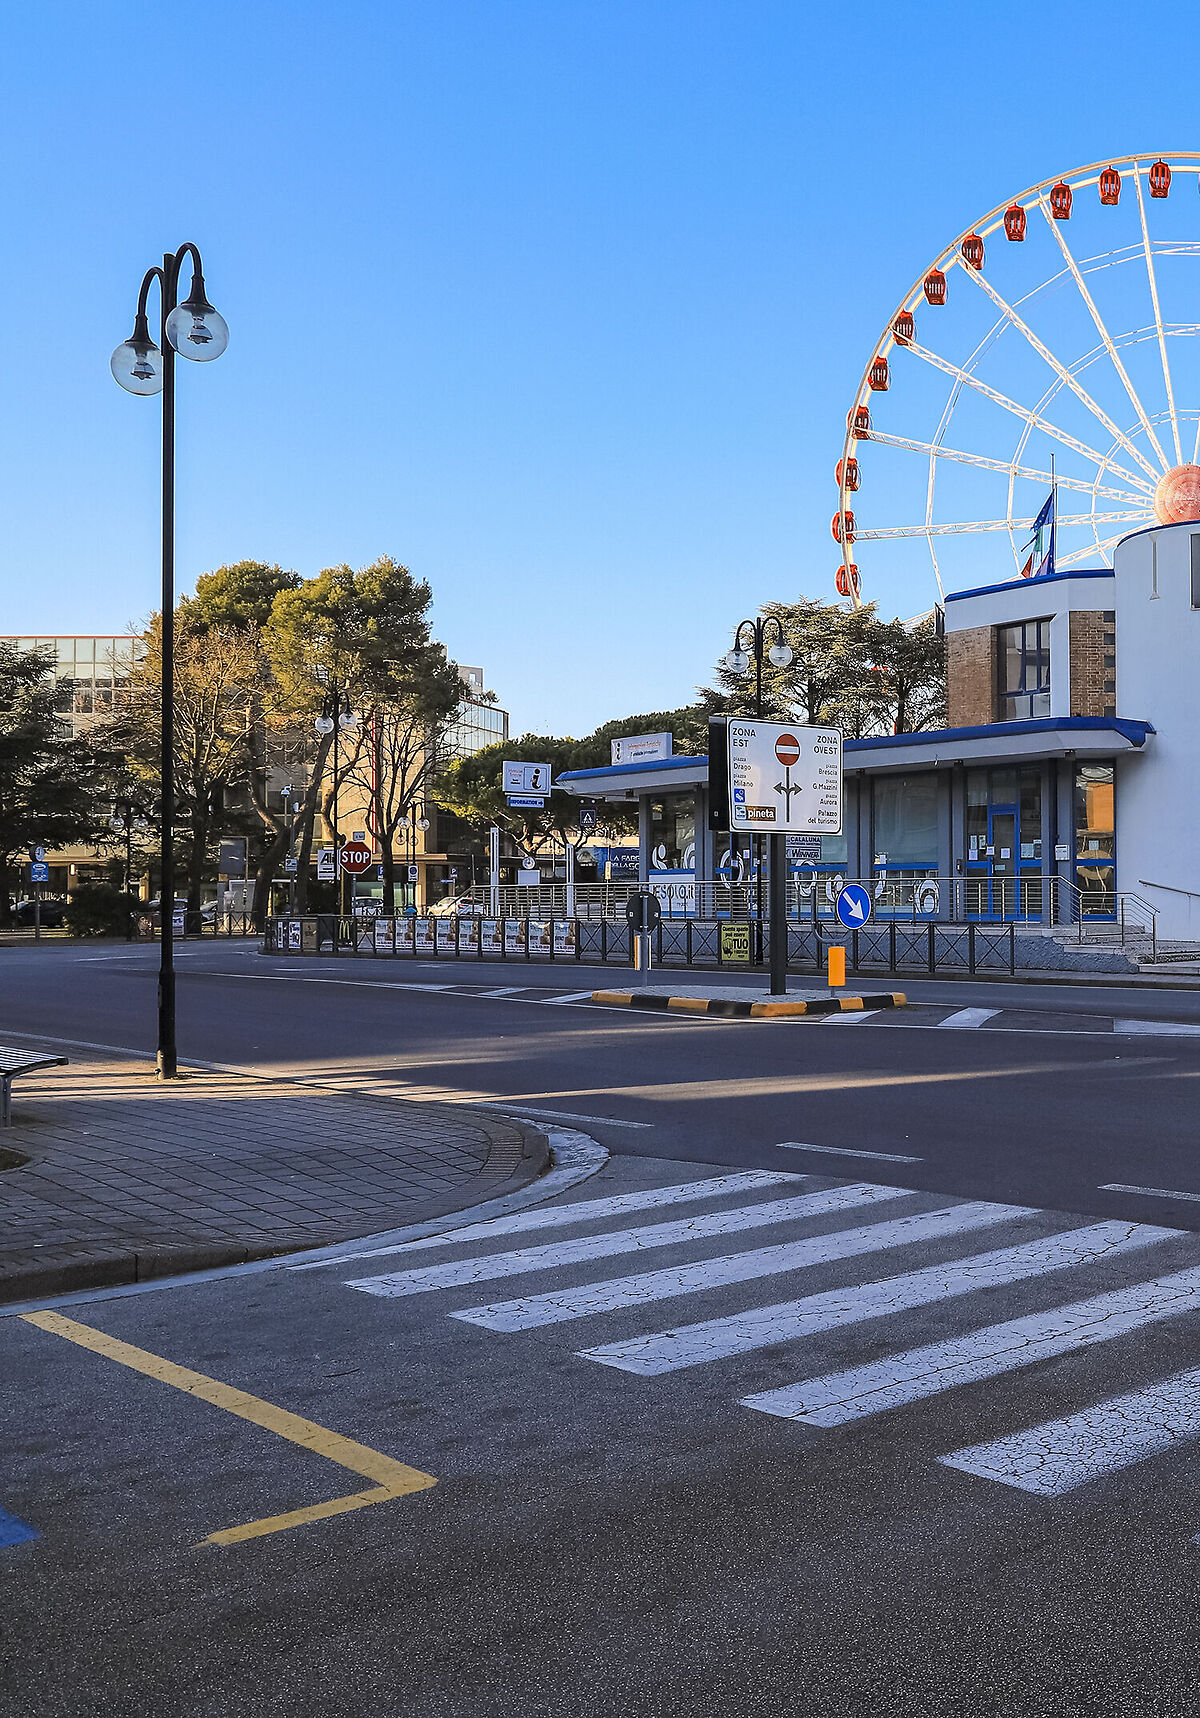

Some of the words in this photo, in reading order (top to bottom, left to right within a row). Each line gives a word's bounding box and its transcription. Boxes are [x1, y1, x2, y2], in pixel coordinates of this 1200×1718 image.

[732, 727, 756, 737] ZONA
[732, 738, 749, 747] EST
[817, 735, 838, 744] ZONA
[813, 745, 838, 754] OVEST
[733, 762, 752, 771] Drago
[818, 768, 838, 776] Brescia
[733, 779, 754, 788] Milano
[748, 808, 775, 819] pineta
[817, 809, 838, 817] Palazzo
[341, 850, 370, 864] STOP
[732, 938, 749, 949] TUO
